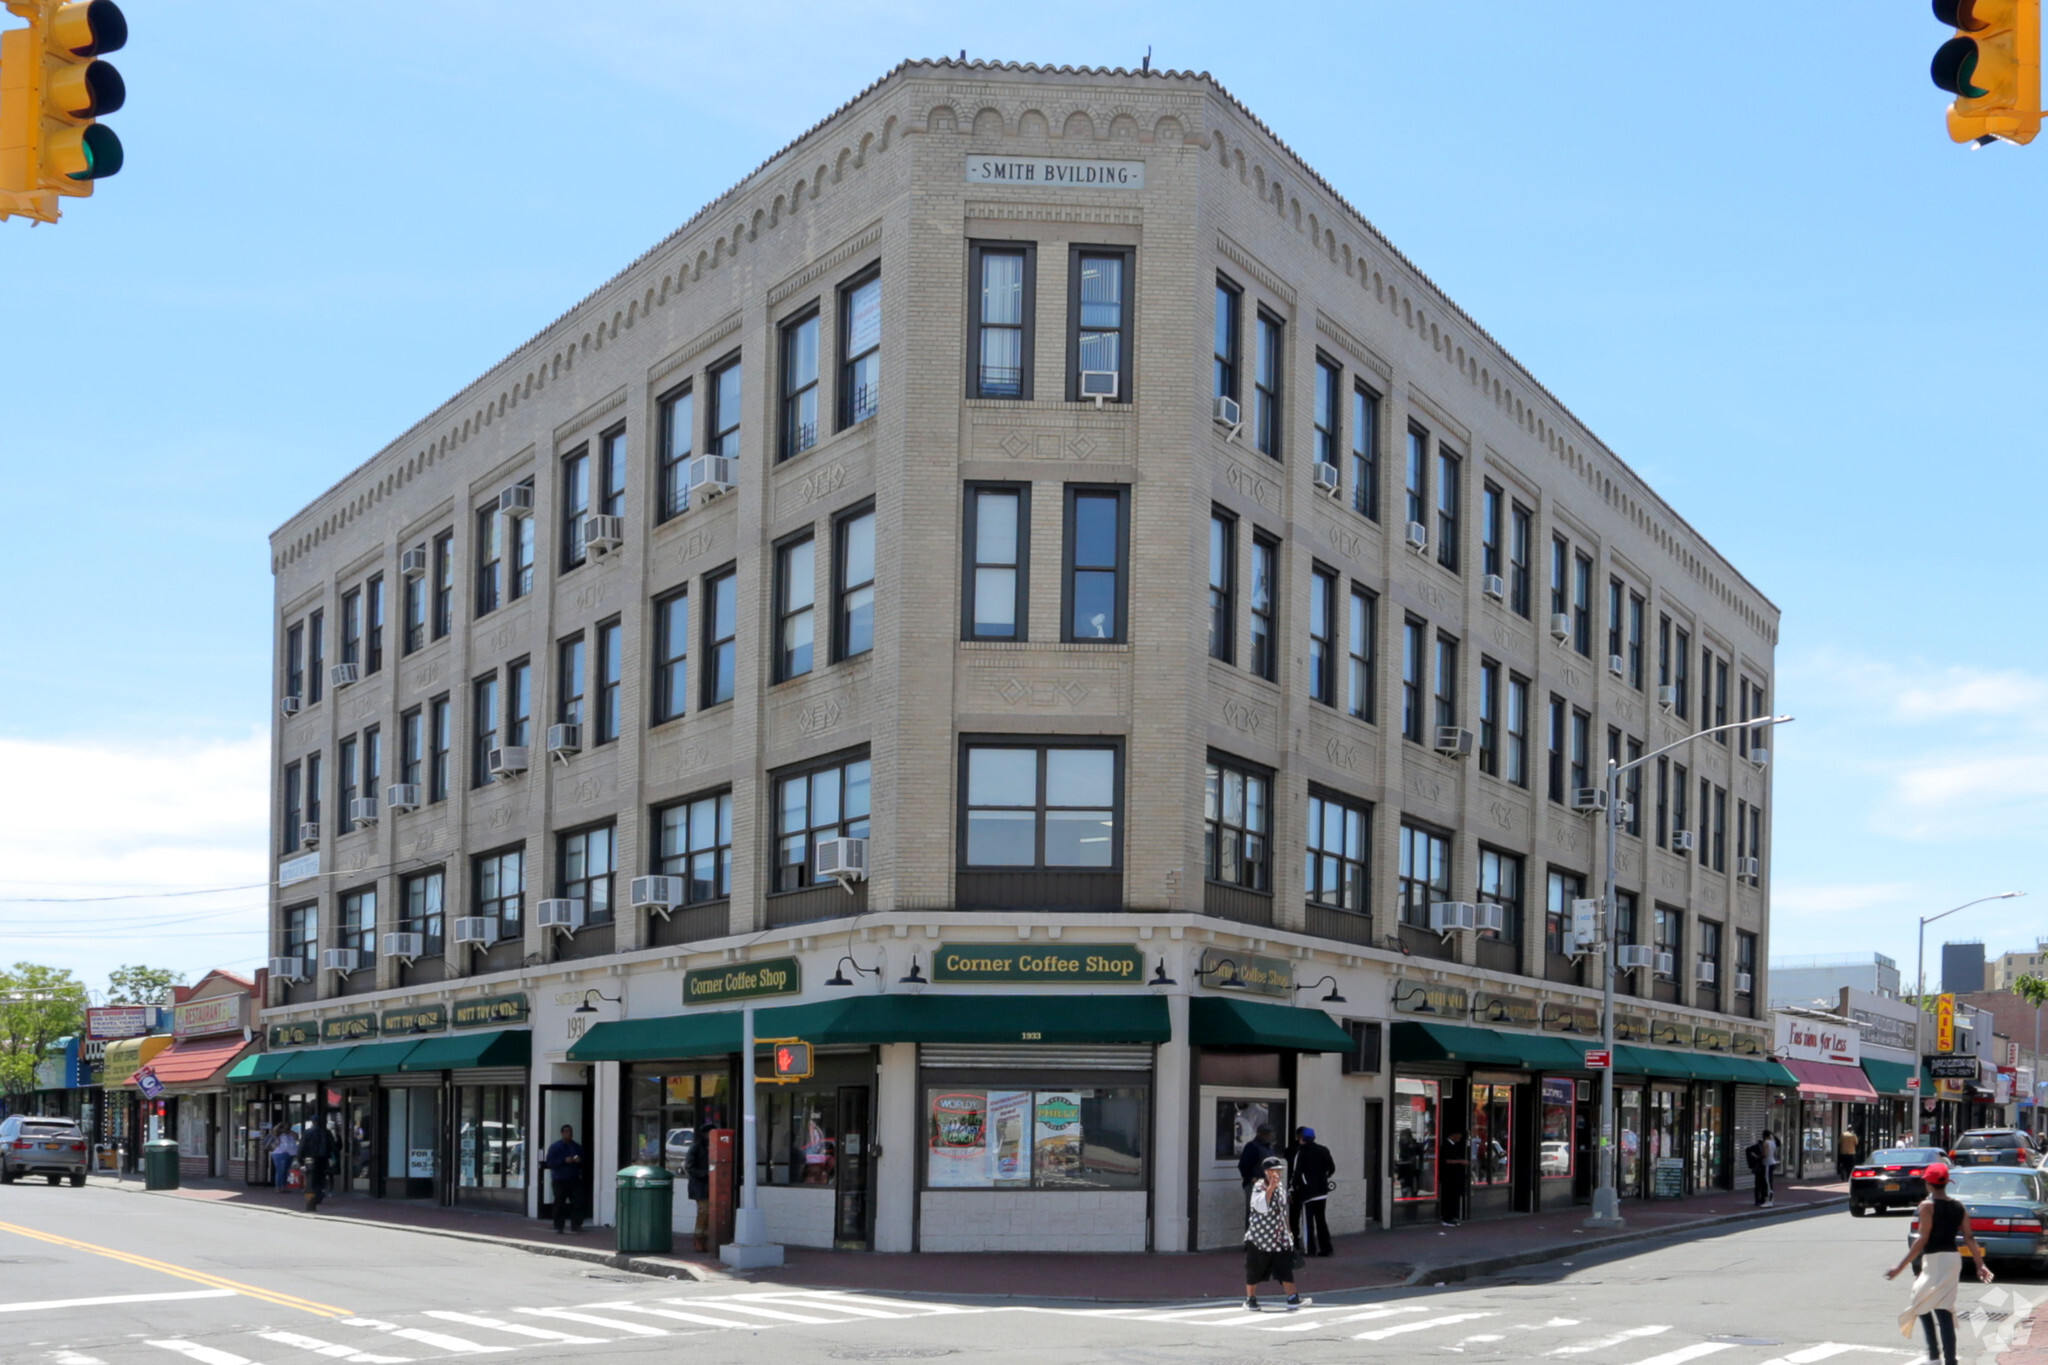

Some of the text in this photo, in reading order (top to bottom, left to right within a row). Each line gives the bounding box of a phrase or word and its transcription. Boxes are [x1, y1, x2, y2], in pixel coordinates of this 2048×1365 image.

[981, 162, 1128, 184] SMITH BVILDING
[946, 954, 1134, 976] Corner Coffee Shop
[690, 968, 787, 996] Corner Coffee Shop
[185, 1002, 221, 1025] RESTAURANT
[1939, 996, 1952, 1050] NAILS
[1021, 1032, 1042, 1040] 1933
[1832, 1033, 1848, 1052] Less
[1037, 1109, 1078, 1118] PHILLY
